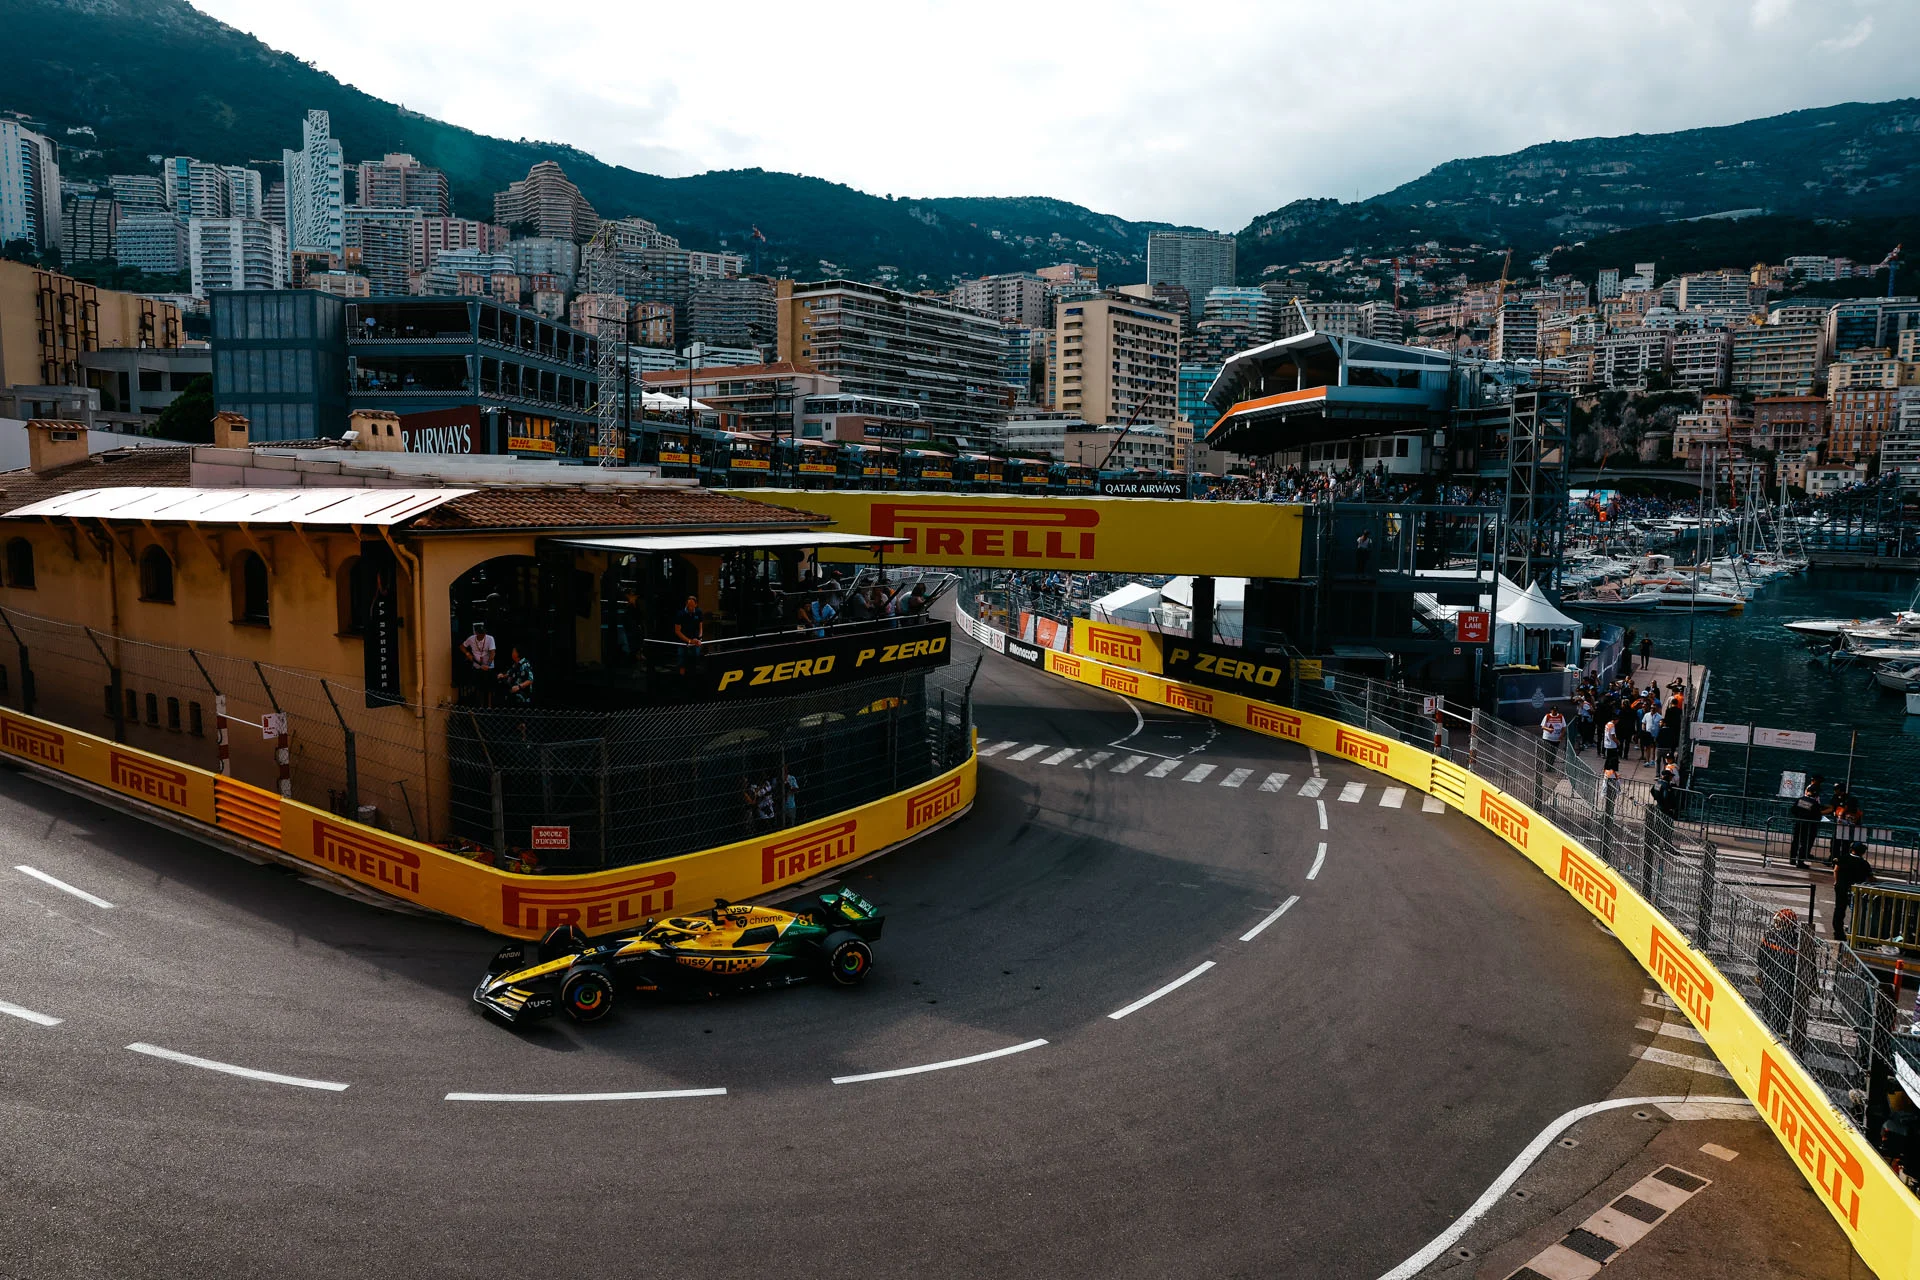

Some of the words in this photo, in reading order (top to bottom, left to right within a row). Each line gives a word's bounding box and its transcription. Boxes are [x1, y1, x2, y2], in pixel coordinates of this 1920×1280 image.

[414, 423, 471, 454] AIRWAYS
[510, 439, 533, 449] DHL
[1105, 484, 1137, 494] QATAR
[1140, 484, 1181, 494] AIRWAYS
[871, 504, 1100, 560] PIRELLI
[378, 601, 385, 616] LA
[379, 621, 388, 688] RASCASSE
[855, 649, 875, 667] P
[880, 637, 947, 663] ZERO
[1009, 642, 1038, 662] #MonacoGP
[1089, 626, 1142, 662] PIRELLI
[718, 669, 743, 691] P
[749, 655, 835, 686] ZERO
[1053, 654, 1080, 678] PIRELLI
[1101, 668, 1139, 694] PIRELLI
[1169, 648, 1190, 664] P
[1194, 653, 1282, 687] ZERO
[1166, 684, 1213, 714] PIRELLI
[1247, 704, 1301, 739] PIRELLI
[1, 716, 64, 765] PIRELLI
[1336, 728, 1389, 769] PIRELLI
[110, 751, 187, 807] PIRELLI
[906, 775, 961, 830] PIRELLI
[1480, 788, 1529, 849] PIRELLI
[313, 819, 421, 894] PIRELLI
[762, 819, 857, 885] PIRELLI
[502, 871, 677, 930] PIRELLI
[1559, 845, 1617, 925] PIRELLI
[749, 914, 783, 925] chrome
[799, 913, 815, 926] 81
[1649, 924, 1714, 1033] PIRELLI
[1757, 1048, 1865, 1233] PIRELLI
